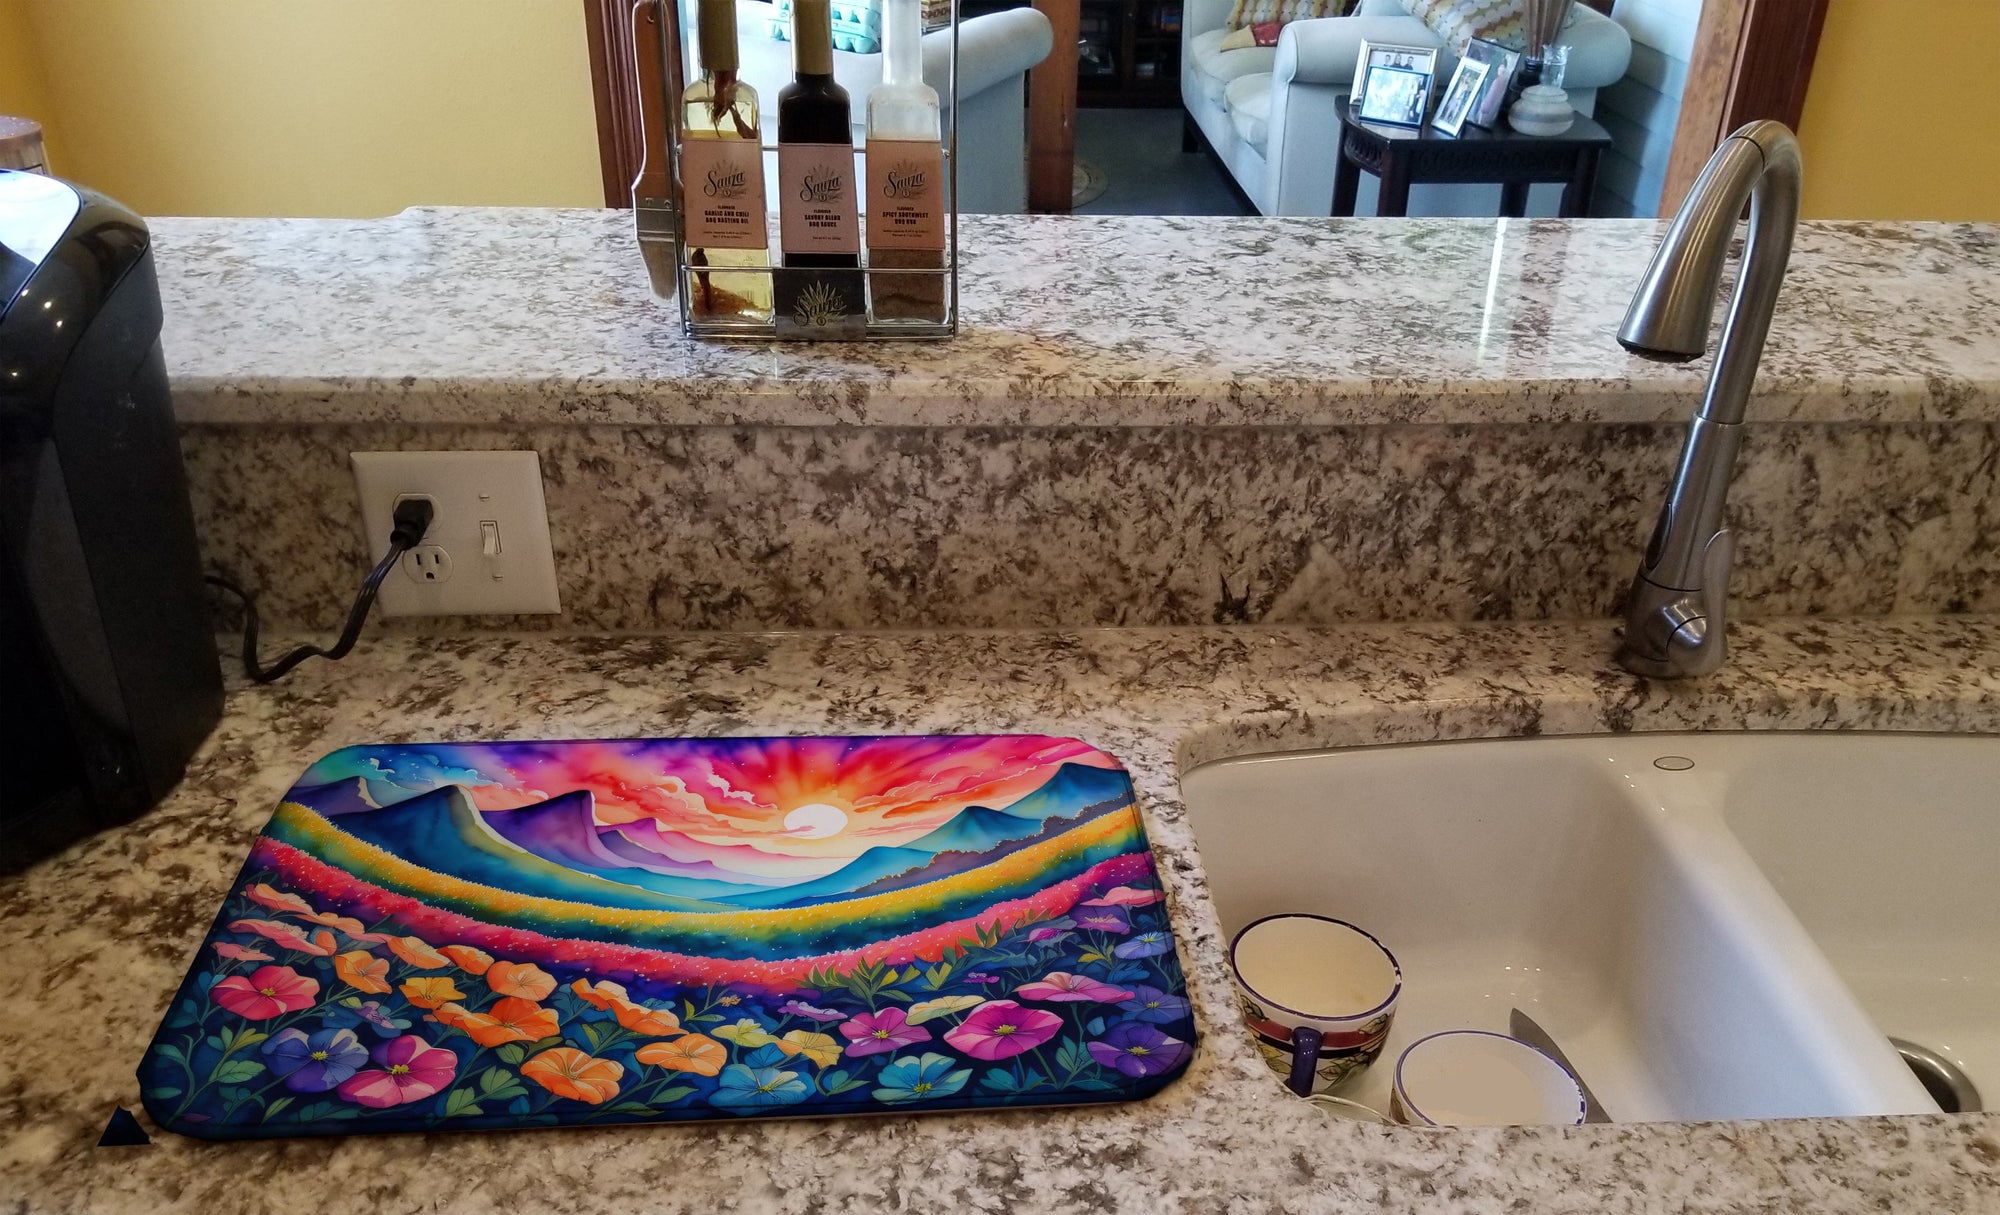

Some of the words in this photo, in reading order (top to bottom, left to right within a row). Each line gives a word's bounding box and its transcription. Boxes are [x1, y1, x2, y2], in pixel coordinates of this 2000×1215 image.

[703, 170, 746, 197] Sauza
[799, 175, 842, 202] Sauza
[883, 171, 926, 198] Sauza
